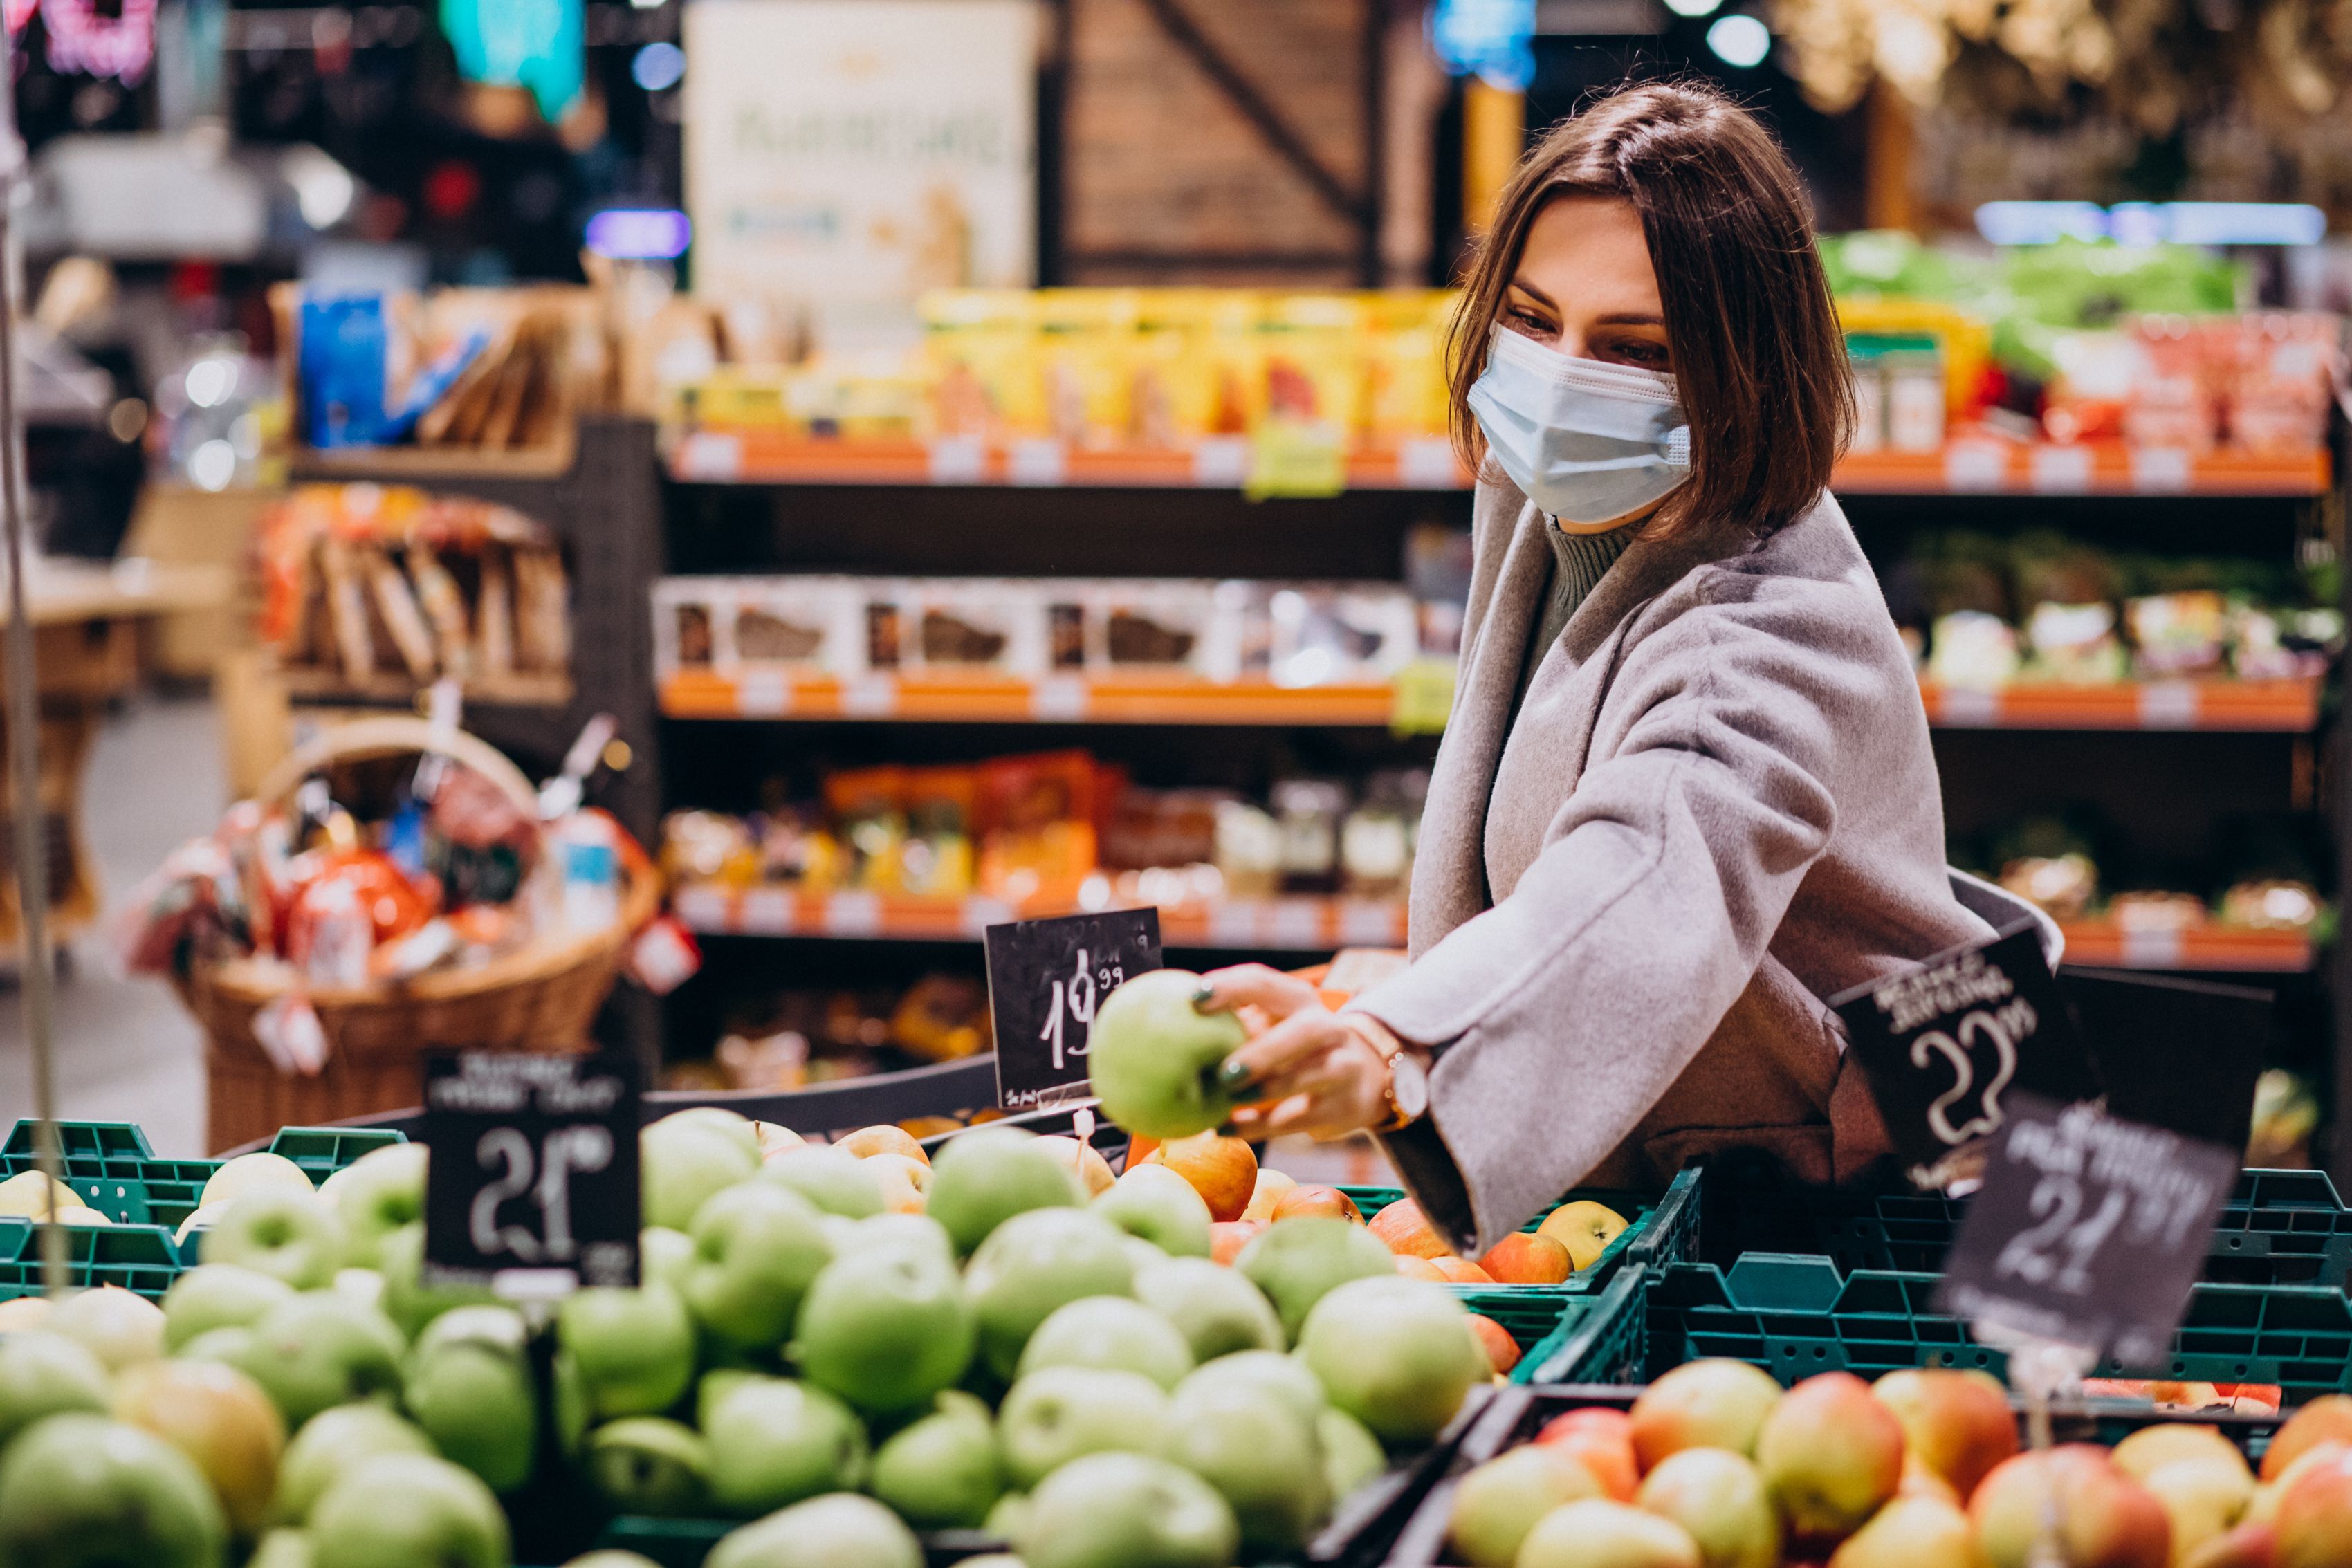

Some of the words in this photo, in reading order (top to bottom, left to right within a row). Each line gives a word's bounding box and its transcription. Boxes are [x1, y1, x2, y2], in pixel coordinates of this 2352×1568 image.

[1040, 948, 1096, 1069] 19
[1910, 1010, 2017, 1145] 22
[470, 1126, 574, 1263] 21
[1997, 1177, 2126, 1295] 21
